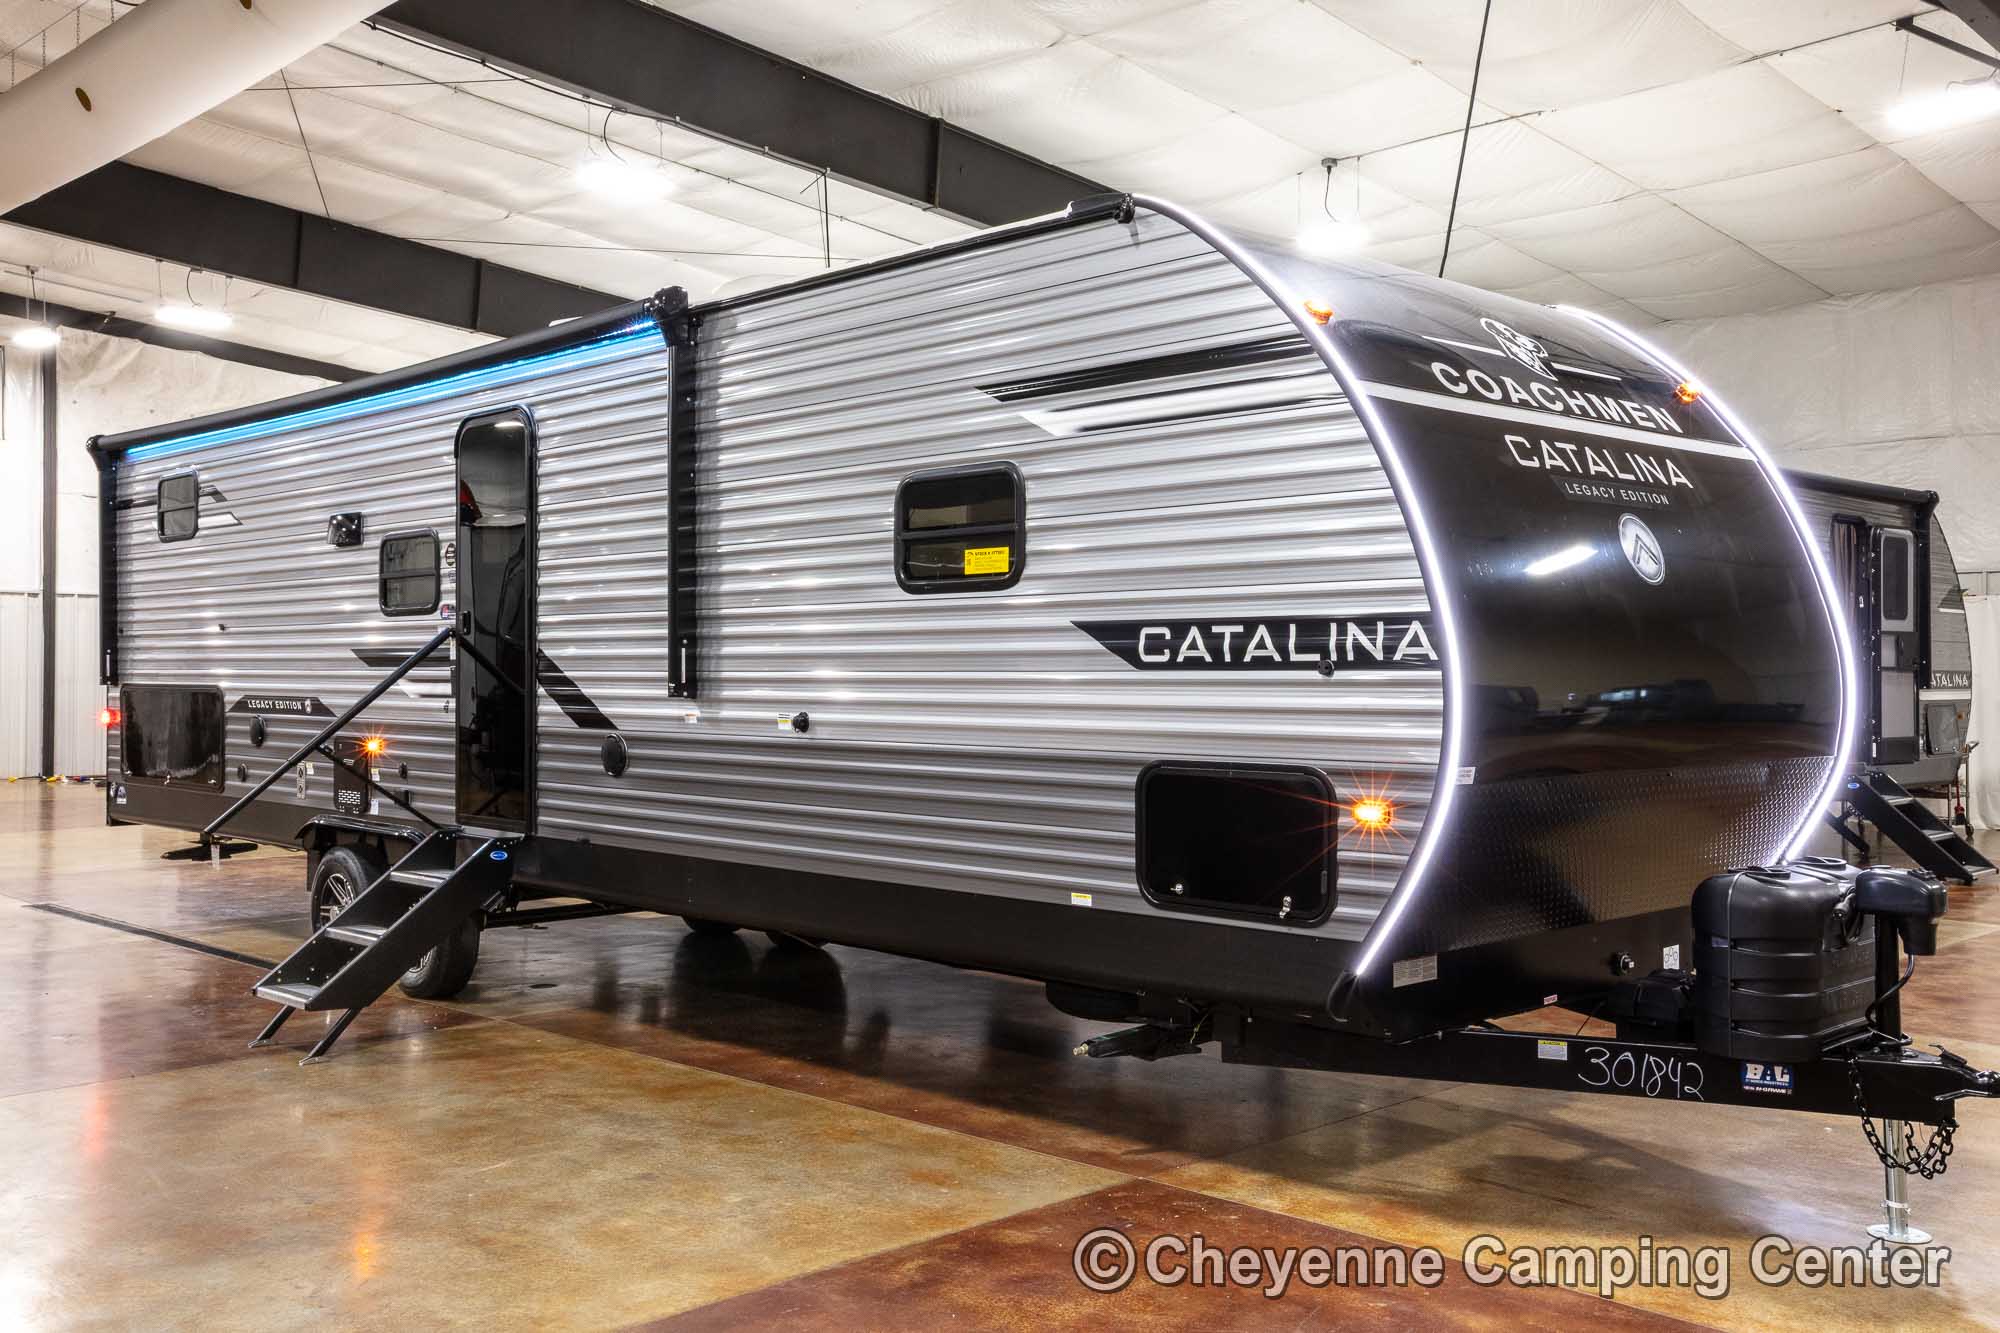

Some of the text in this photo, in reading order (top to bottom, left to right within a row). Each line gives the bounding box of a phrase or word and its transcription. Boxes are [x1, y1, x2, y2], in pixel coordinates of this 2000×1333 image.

[1430, 361, 1684, 434] COACHMEN
[1504, 434, 1694, 489] CATALINA
[1564, 482, 1670, 505] LEGACY EDITION
[1138, 620, 1439, 663] CATALINA
[1930, 673, 1970, 687] ATALINA
[247, 699, 302, 710] LEGACY EDITION
[1577, 1046, 1705, 1101] 301842
